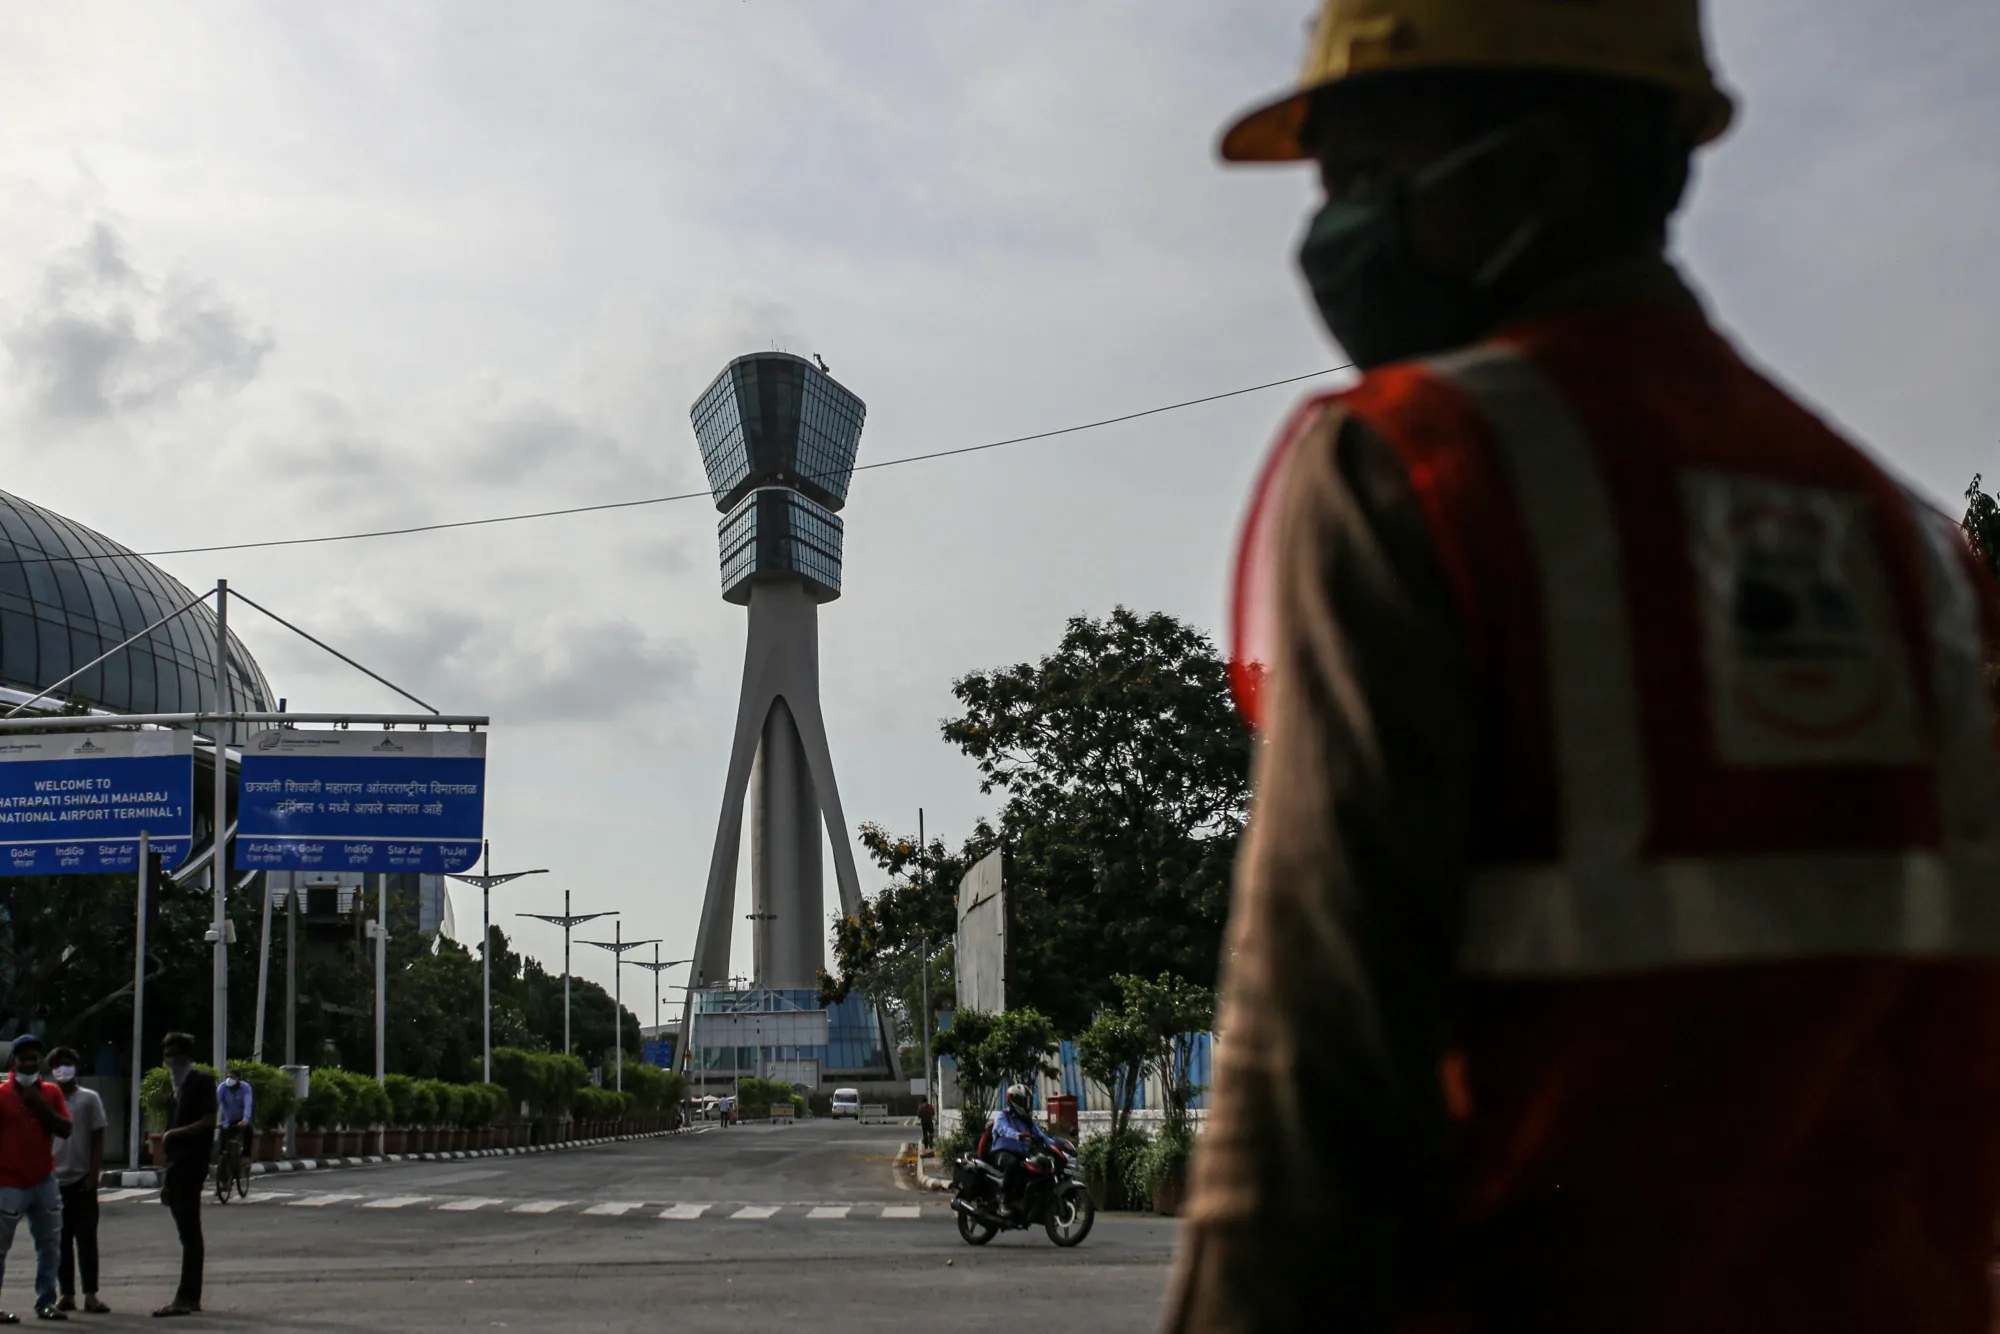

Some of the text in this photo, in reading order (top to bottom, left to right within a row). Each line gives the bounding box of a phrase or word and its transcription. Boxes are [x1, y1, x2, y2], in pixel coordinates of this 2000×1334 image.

[34, 777, 111, 792] WELCOME TO
[245, 779, 478, 797] छत्रपती शिवाजी महाराज आंतरराष्ट्रीय विमानतळ
[64, 793, 109, 806] SHIVAJI
[111, 791, 168, 804] MAHARAJ
[276, 799, 444, 815] टर्मिनल १ मध्ये आपले स्वागत आहे
[0, 806, 182, 823] NATIONAL AIRPORT TERMINAL 1
[10, 848, 36, 858] GoAir
[55, 846, 84, 856] IndiGo
[98, 845, 133, 855] Star Air
[148, 844, 177, 853] TruJet
[248, 843, 283, 853] AirAsia
[298, 844, 325, 853] GoAir
[344, 844, 374, 853] IndiGo
[387, 845, 423, 855] Star Air
[439, 846, 467, 856] TruJet
